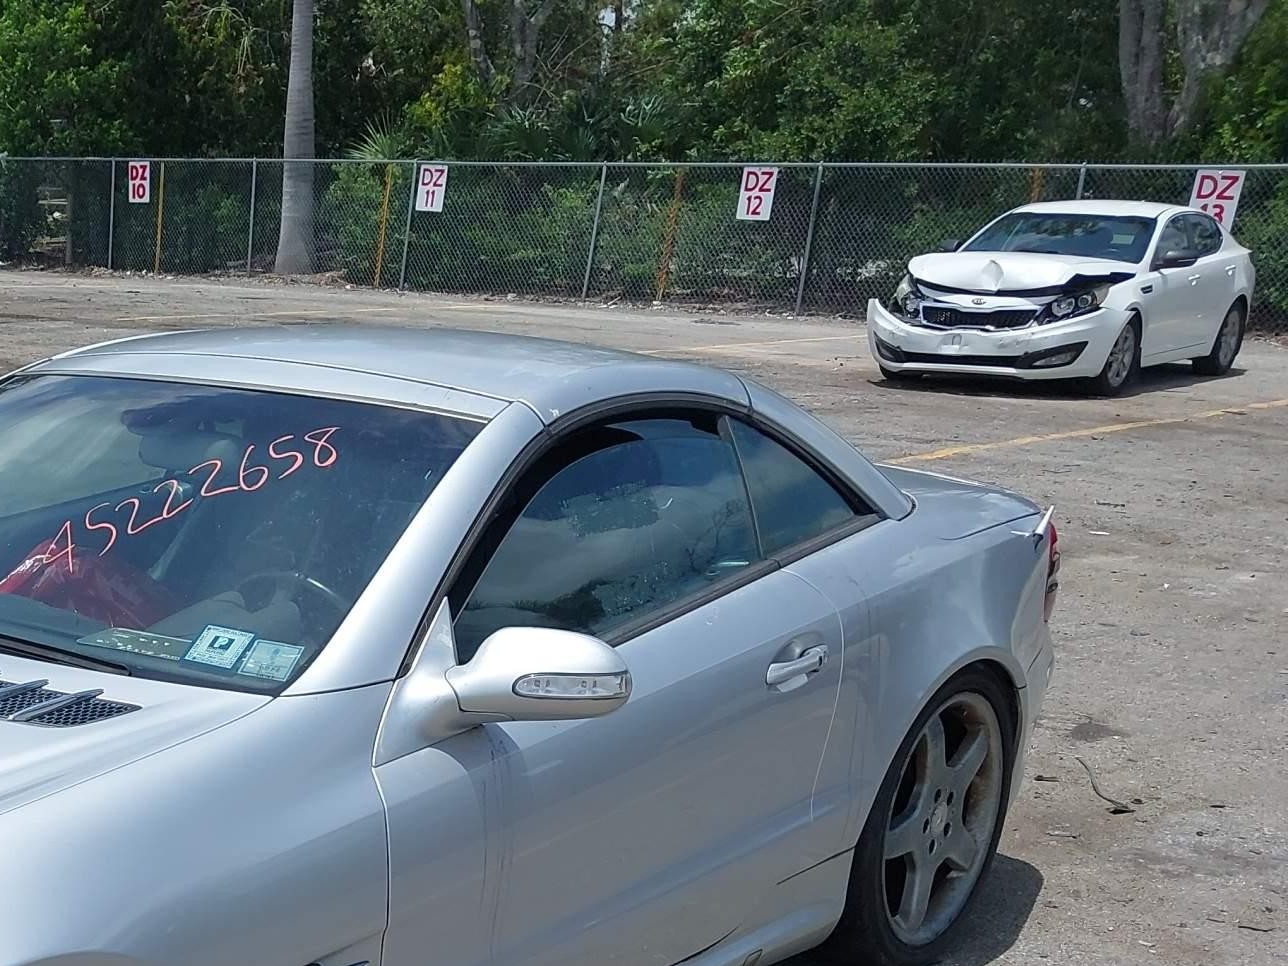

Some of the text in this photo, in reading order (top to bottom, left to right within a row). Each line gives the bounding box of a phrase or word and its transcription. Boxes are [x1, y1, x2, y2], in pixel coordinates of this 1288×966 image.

[130, 164, 148, 182] DZ
[421, 168, 446, 187] DZ
[744, 171, 774, 193] DZ
[132, 183, 146, 199] 10
[1196, 174, 1241, 201] DZ
[424, 190, 436, 208] 11
[745, 195, 763, 216] 12
